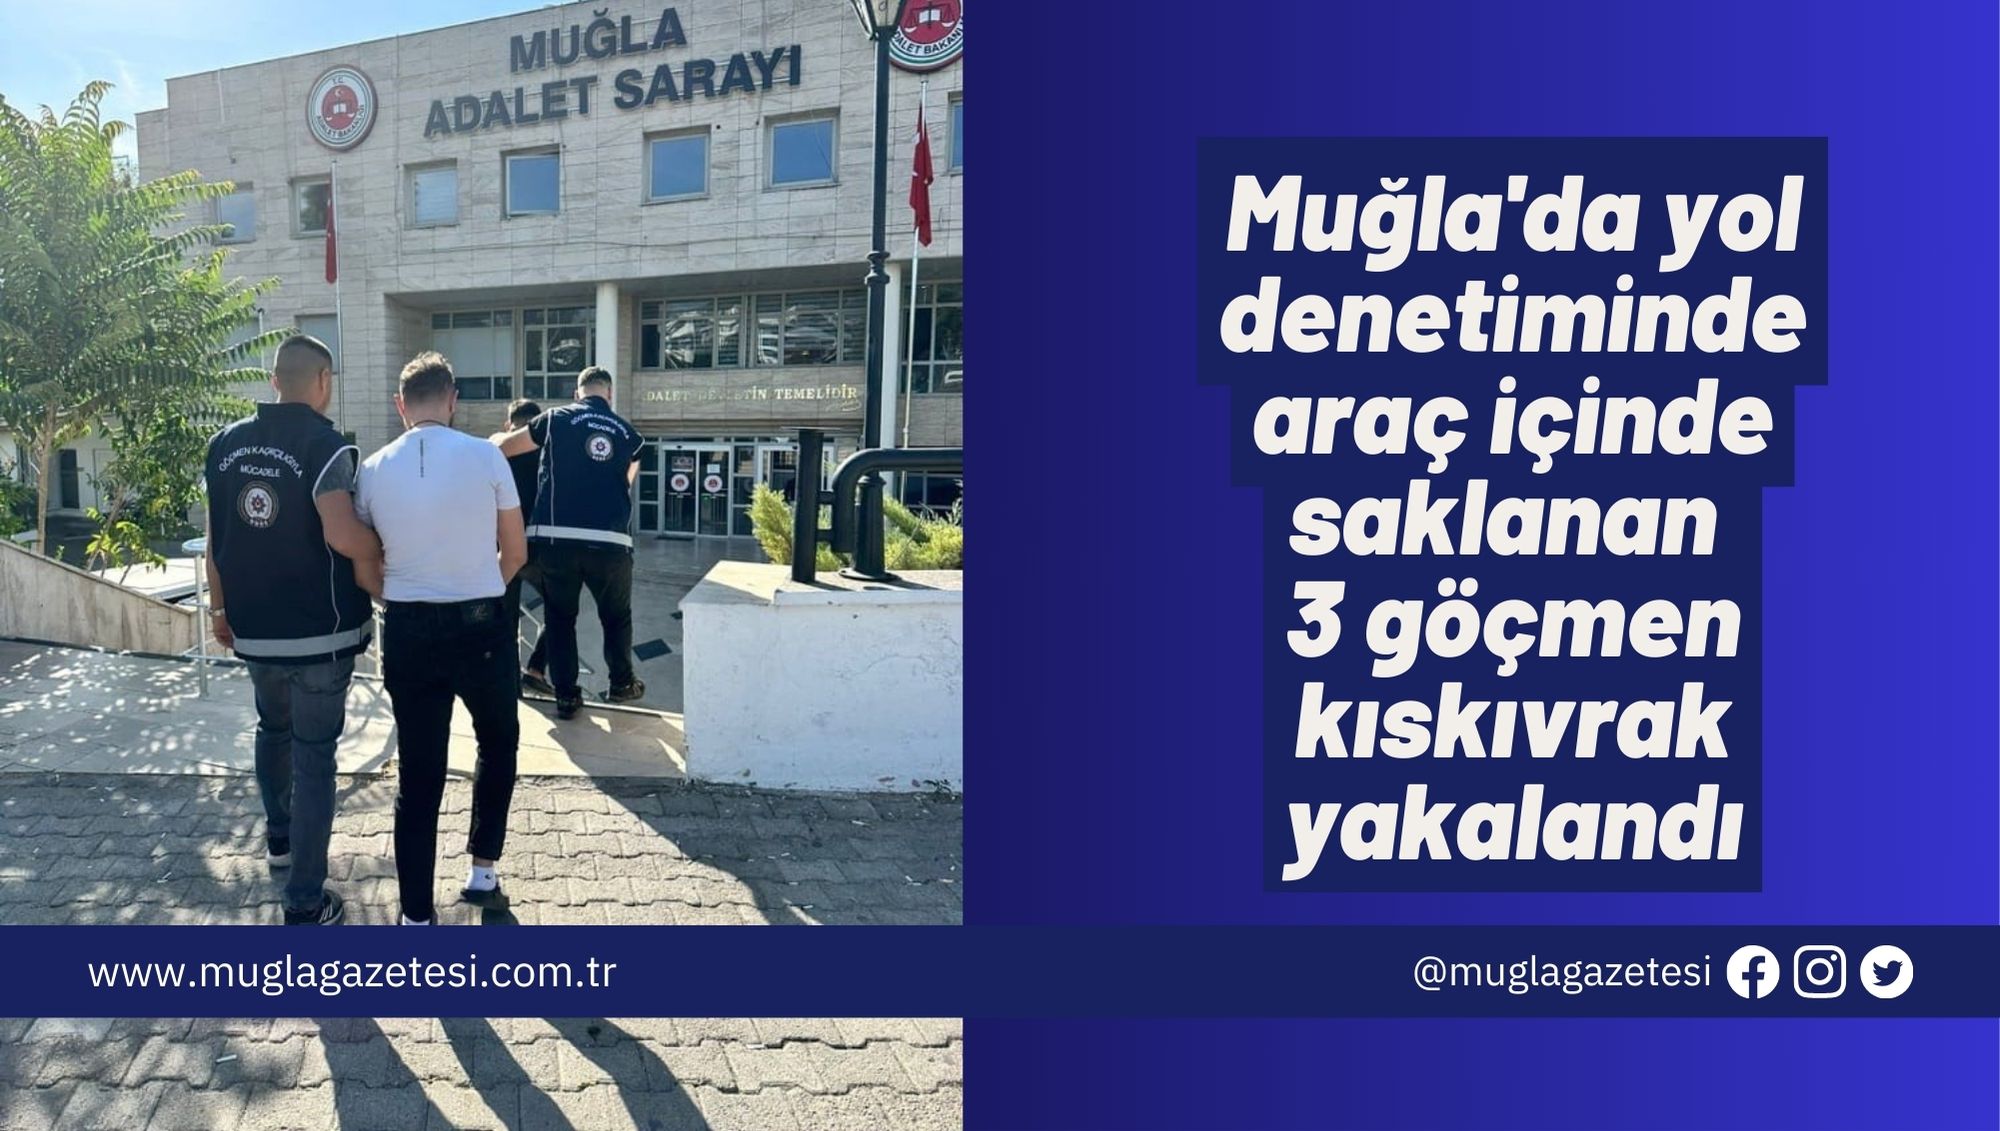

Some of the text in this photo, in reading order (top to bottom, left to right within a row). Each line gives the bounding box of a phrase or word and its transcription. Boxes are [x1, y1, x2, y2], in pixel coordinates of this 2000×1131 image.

[510, 7, 687, 73] MUĞLA
[893, 29, 922, 54] DALET
[424, 44, 802, 138] ADALET SARAYI
[641, 384, 857, 402] DALET DEETİN TEMELİDİR
[240, 464, 280, 477] MÜCADELE
